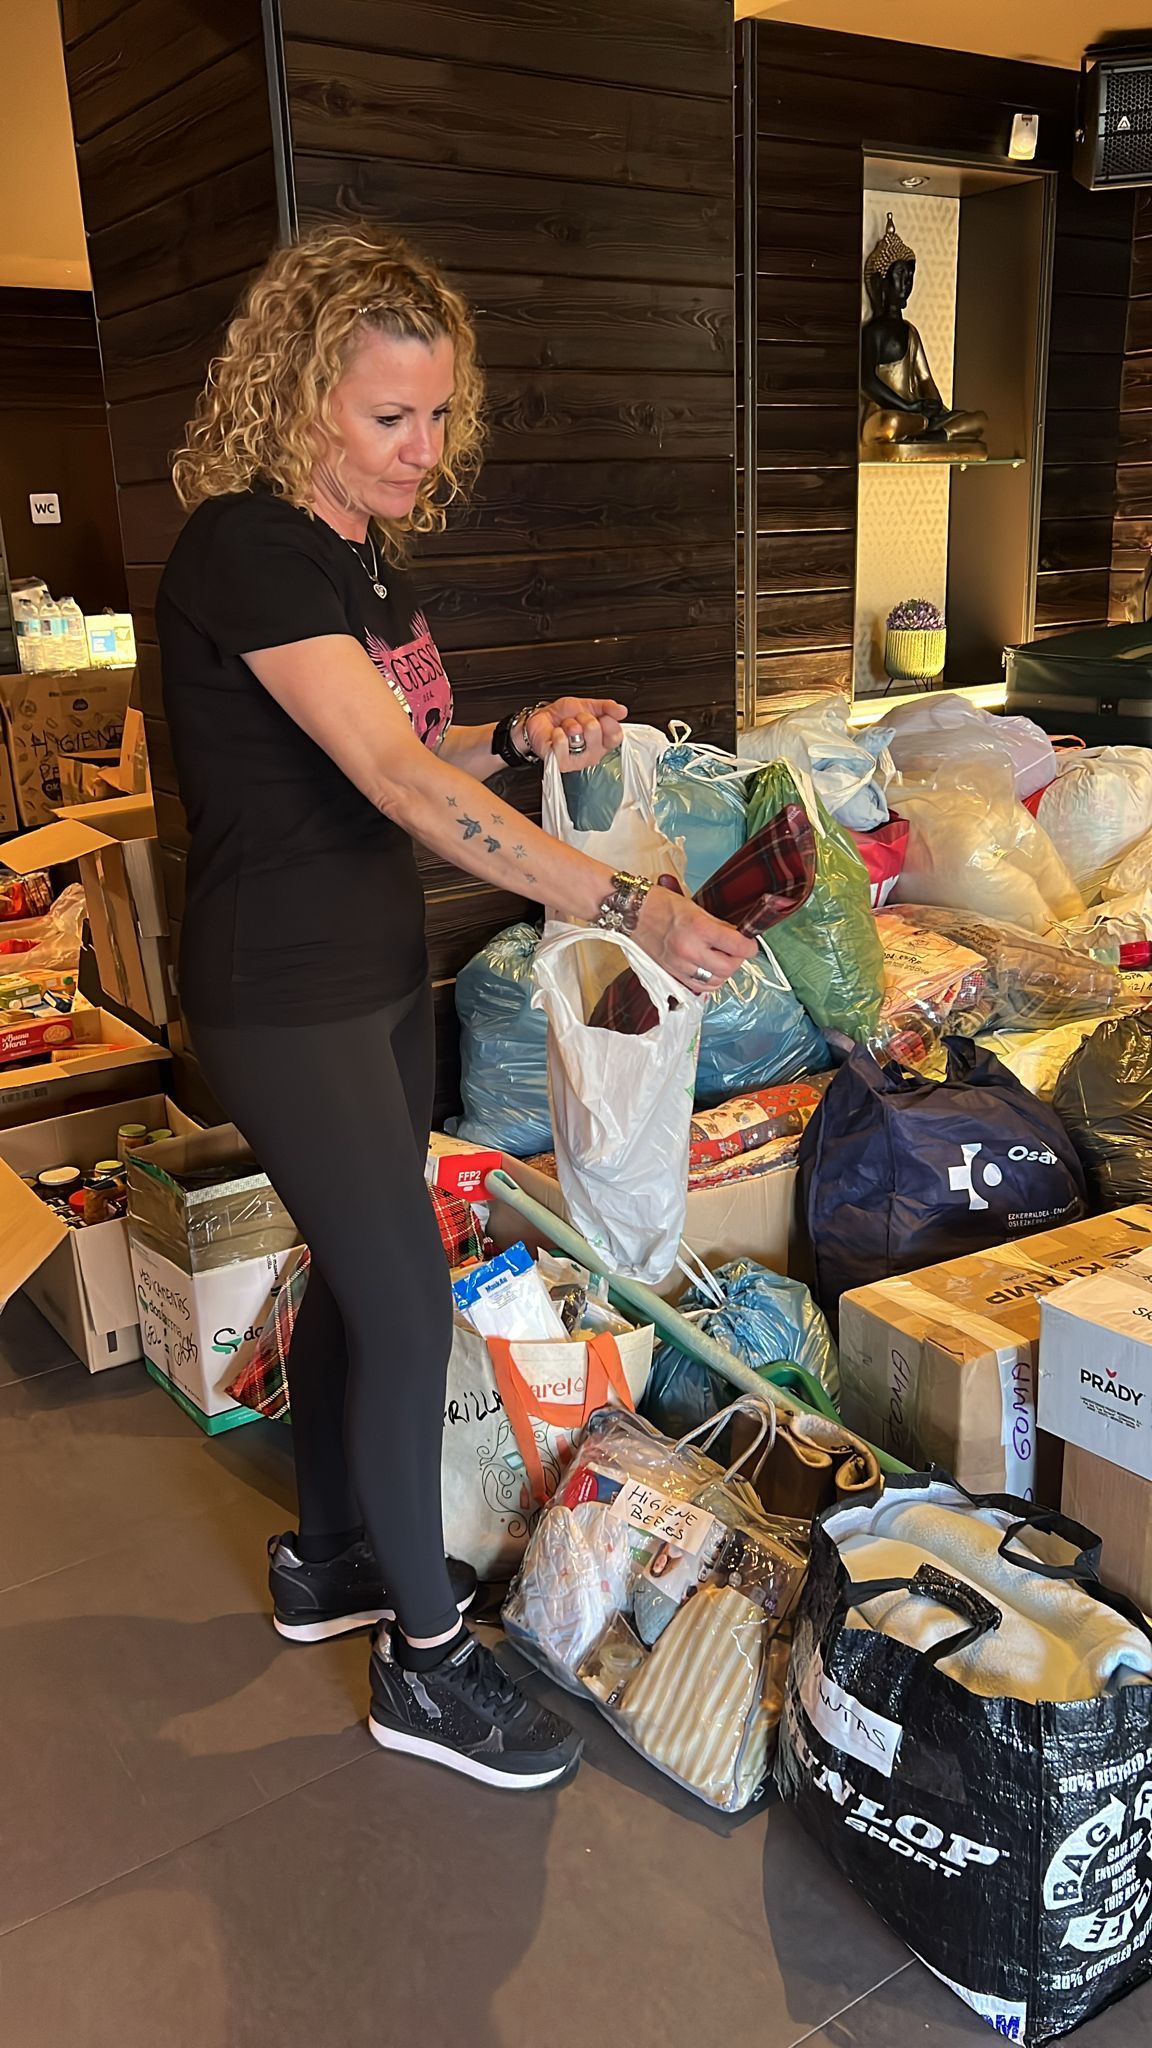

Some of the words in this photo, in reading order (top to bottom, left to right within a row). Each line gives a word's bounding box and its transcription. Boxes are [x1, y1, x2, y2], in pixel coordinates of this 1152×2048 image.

[34, 503, 56, 514] WC
[458, 1170, 481, 1182] FFP2
[1080, 1368, 1144, 1406] PRADY
[1059, 1771, 1094, 1793] 30%
[845, 1816, 962, 1879] SPORT
[1053, 1821, 1111, 1901] BAG
[1104, 1890, 1124, 1913] THIS
[1052, 1973, 1084, 1990] 30%
